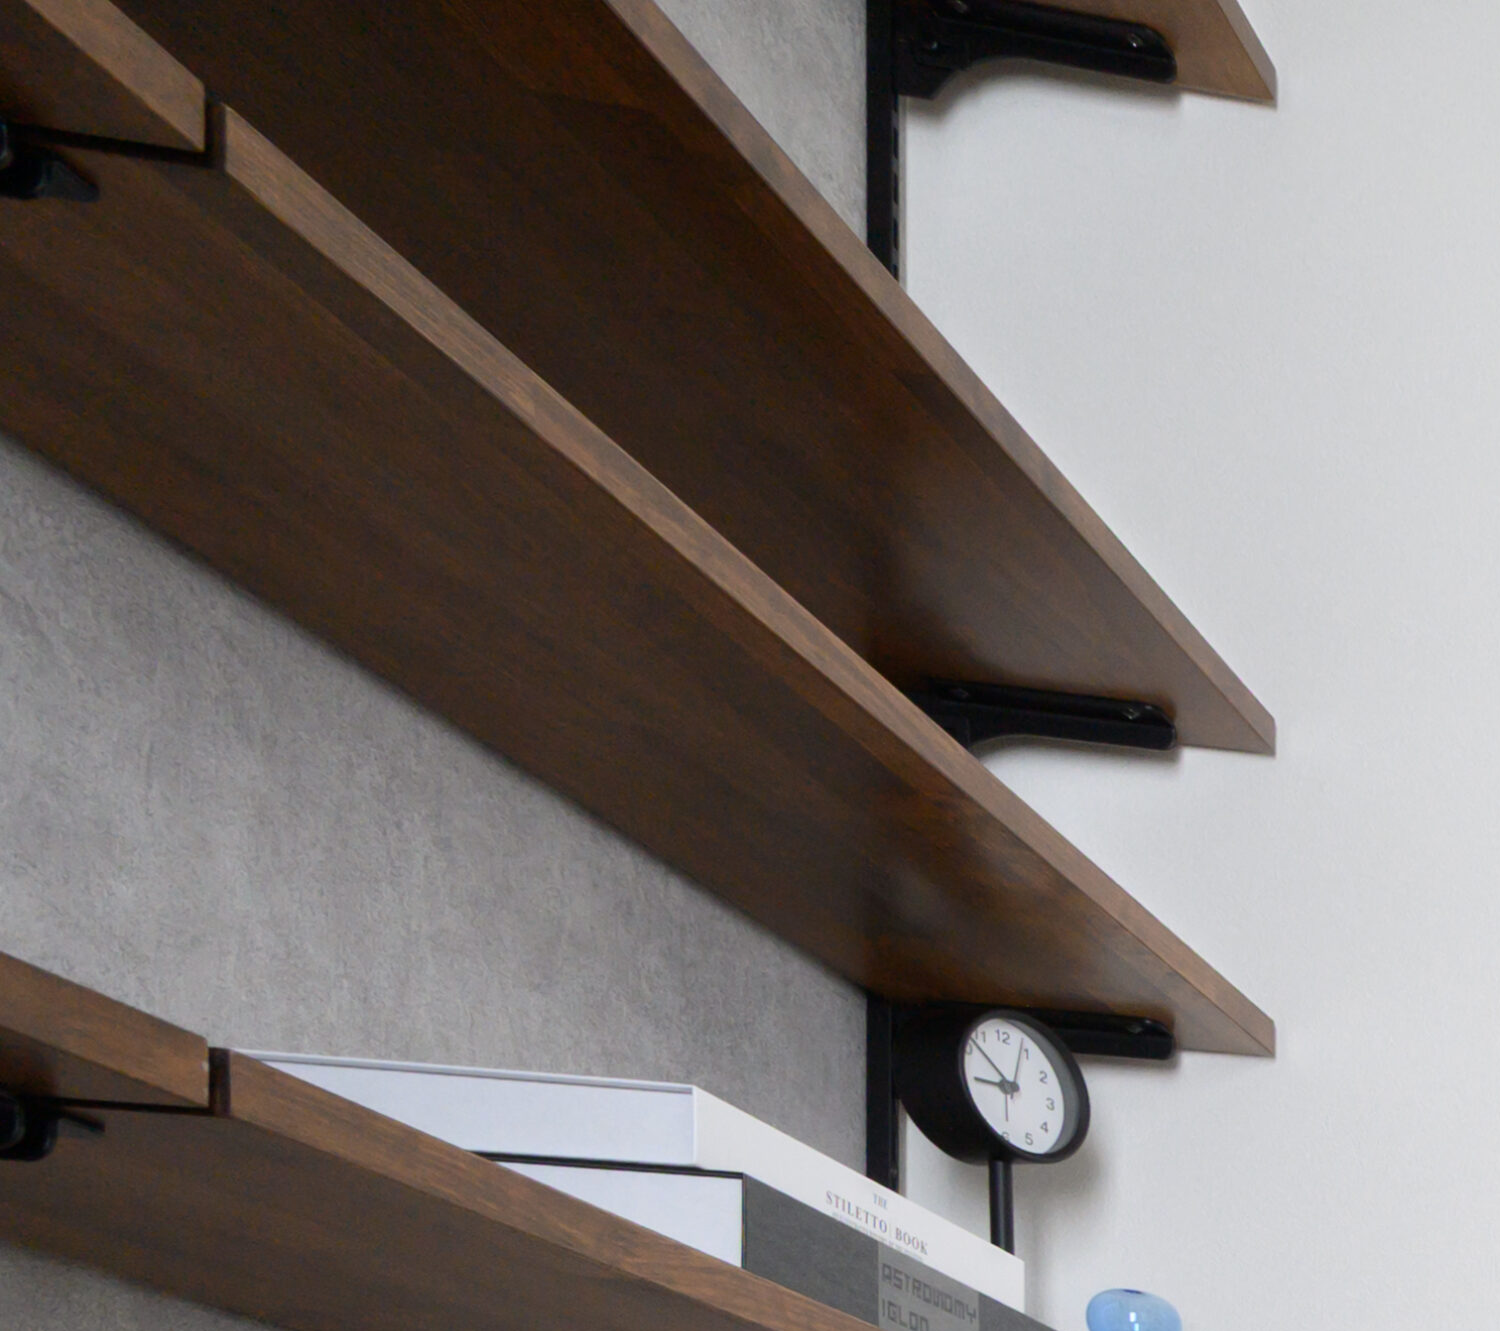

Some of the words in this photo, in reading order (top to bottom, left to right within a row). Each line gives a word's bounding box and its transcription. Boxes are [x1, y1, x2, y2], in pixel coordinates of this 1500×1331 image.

[994, 1028, 1010, 1046] 12
[1023, 1048, 1030, 1060] 1
[1039, 1070, 1048, 1084] 2
[1046, 1097, 1055, 1111] 3
[1040, 1121, 1049, 1133] 4
[1024, 1132, 1034, 1146] 5
[825, 1190, 888, 1234] STILETTO
[895, 1226, 928, 1255] BOOK
[881, 1263, 977, 1325] ASTRONOMY
